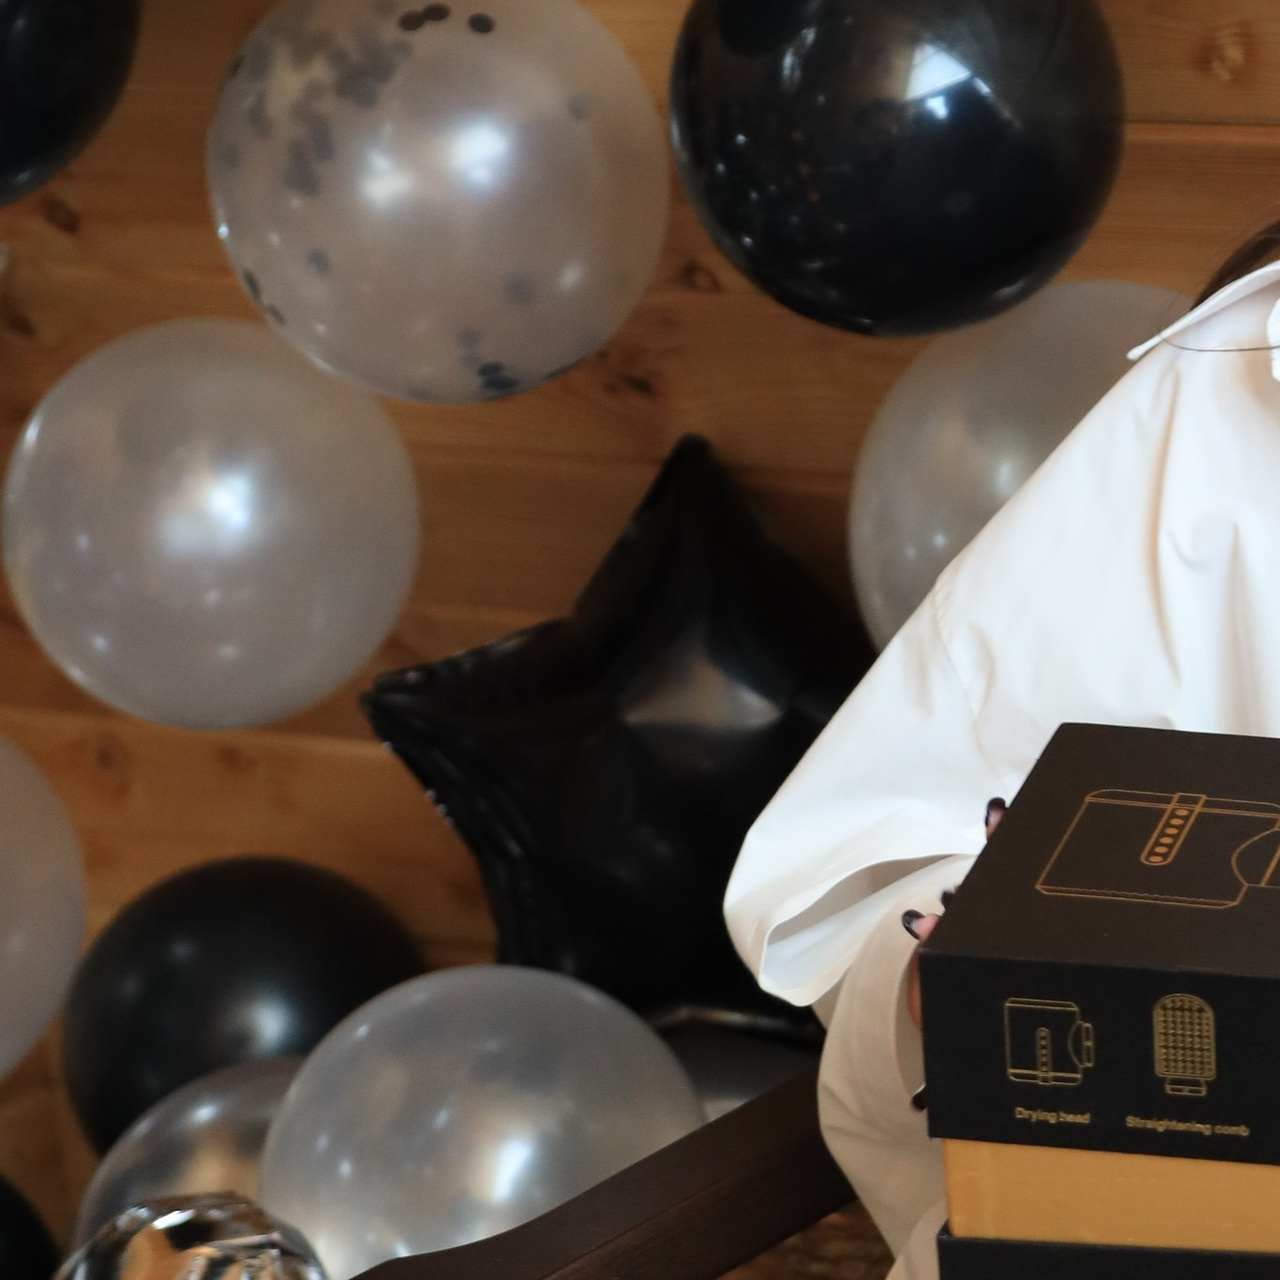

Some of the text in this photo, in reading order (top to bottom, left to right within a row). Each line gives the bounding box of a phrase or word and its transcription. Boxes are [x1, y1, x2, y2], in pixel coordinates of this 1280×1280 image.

[1014, 1106, 1057, 1124] Drying
[1125, 1115, 1251, 1137] Straightening comb
